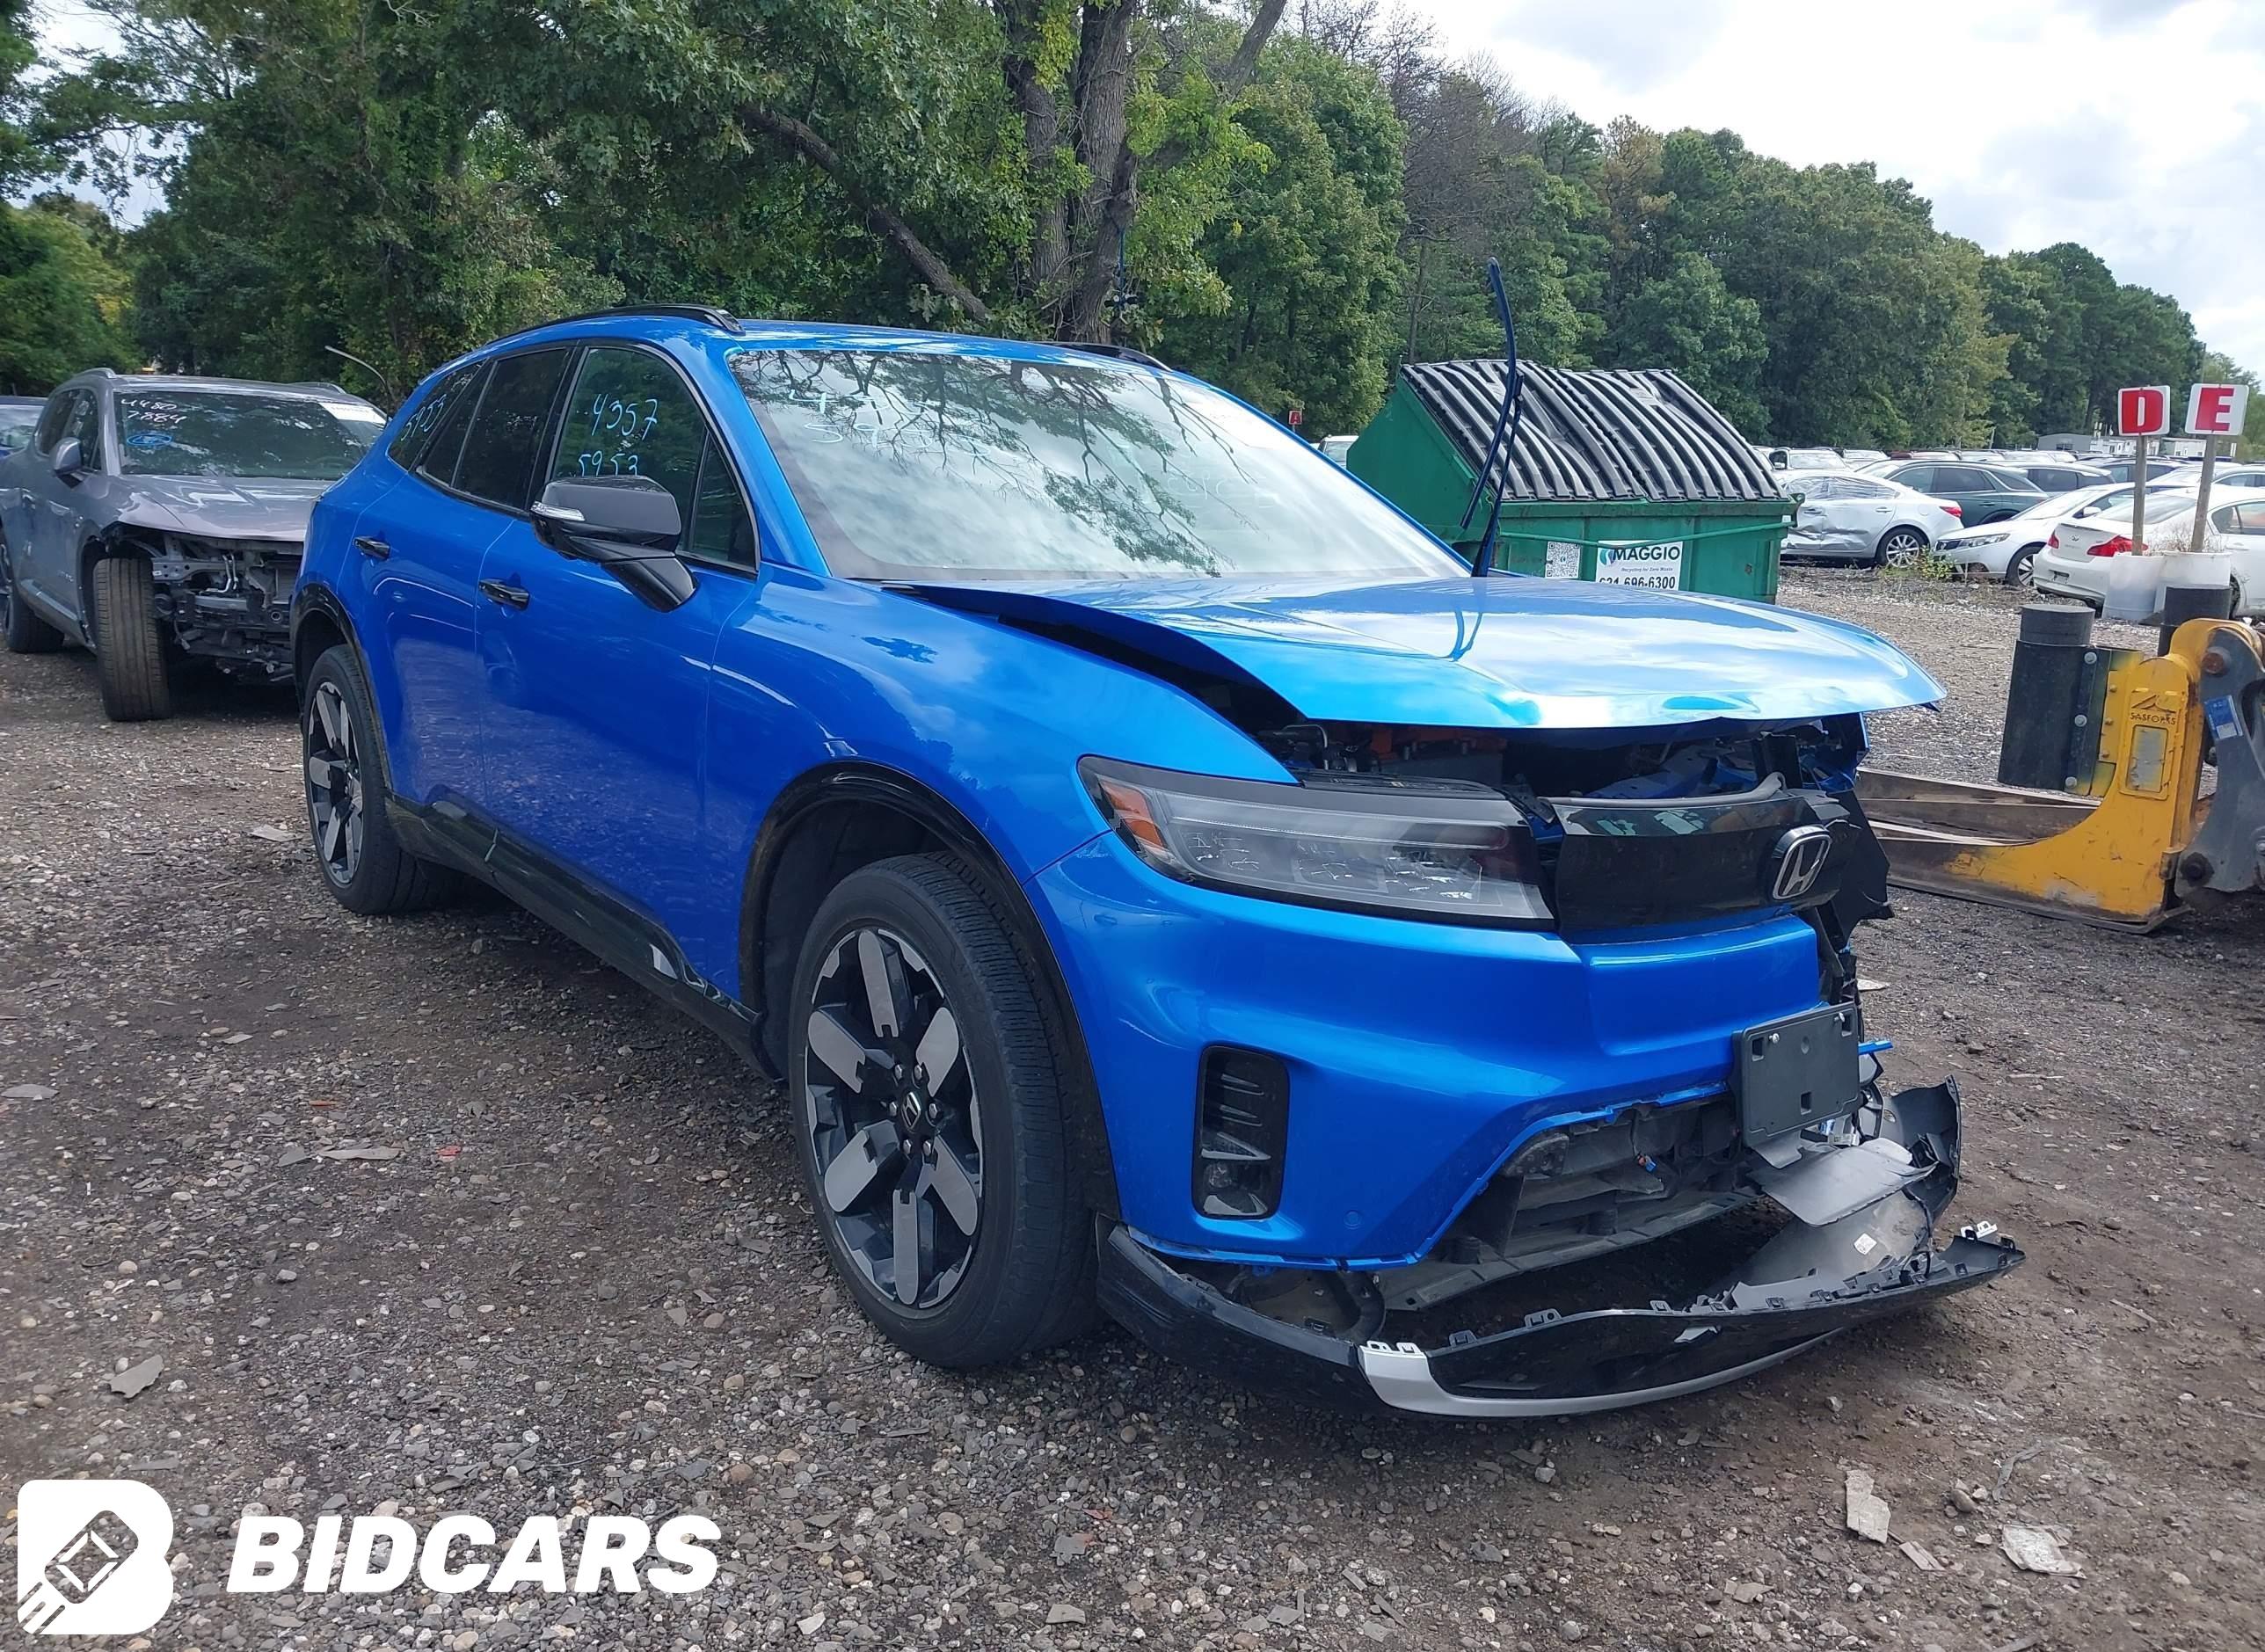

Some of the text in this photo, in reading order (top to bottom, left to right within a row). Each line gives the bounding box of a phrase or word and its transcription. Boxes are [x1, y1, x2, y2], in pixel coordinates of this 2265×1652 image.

[1290, 411, 1301, 424] A
[2121, 389, 2164, 434] D
[2195, 387, 2234, 432] E
[1613, 546, 1680, 561] MAGGIO
